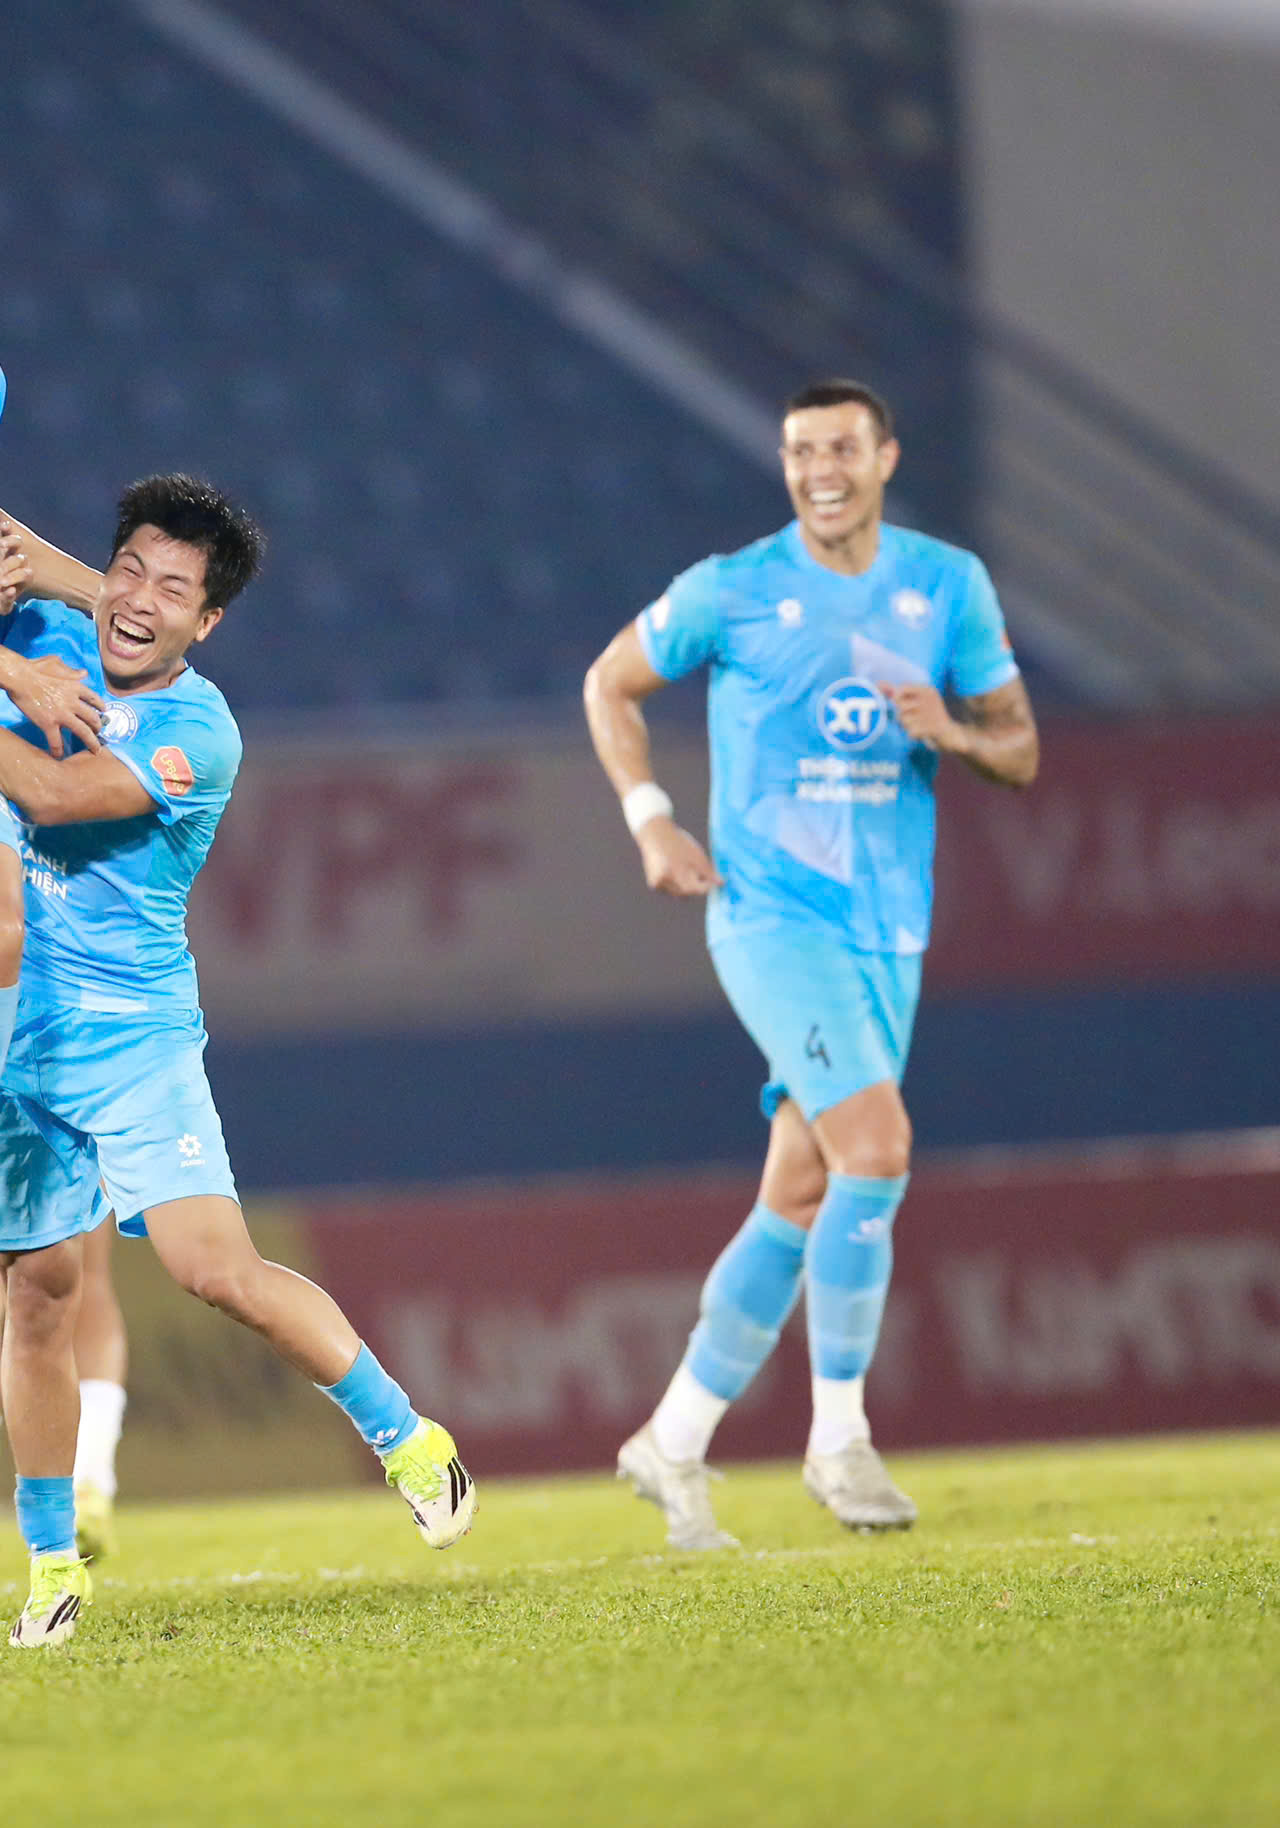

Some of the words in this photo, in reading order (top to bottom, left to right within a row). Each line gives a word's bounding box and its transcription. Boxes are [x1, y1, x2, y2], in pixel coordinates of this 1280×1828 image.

[827, 696, 877, 735] XT
[22, 866, 68, 900] HIỆN
[805, 1023, 831, 1069] 4
